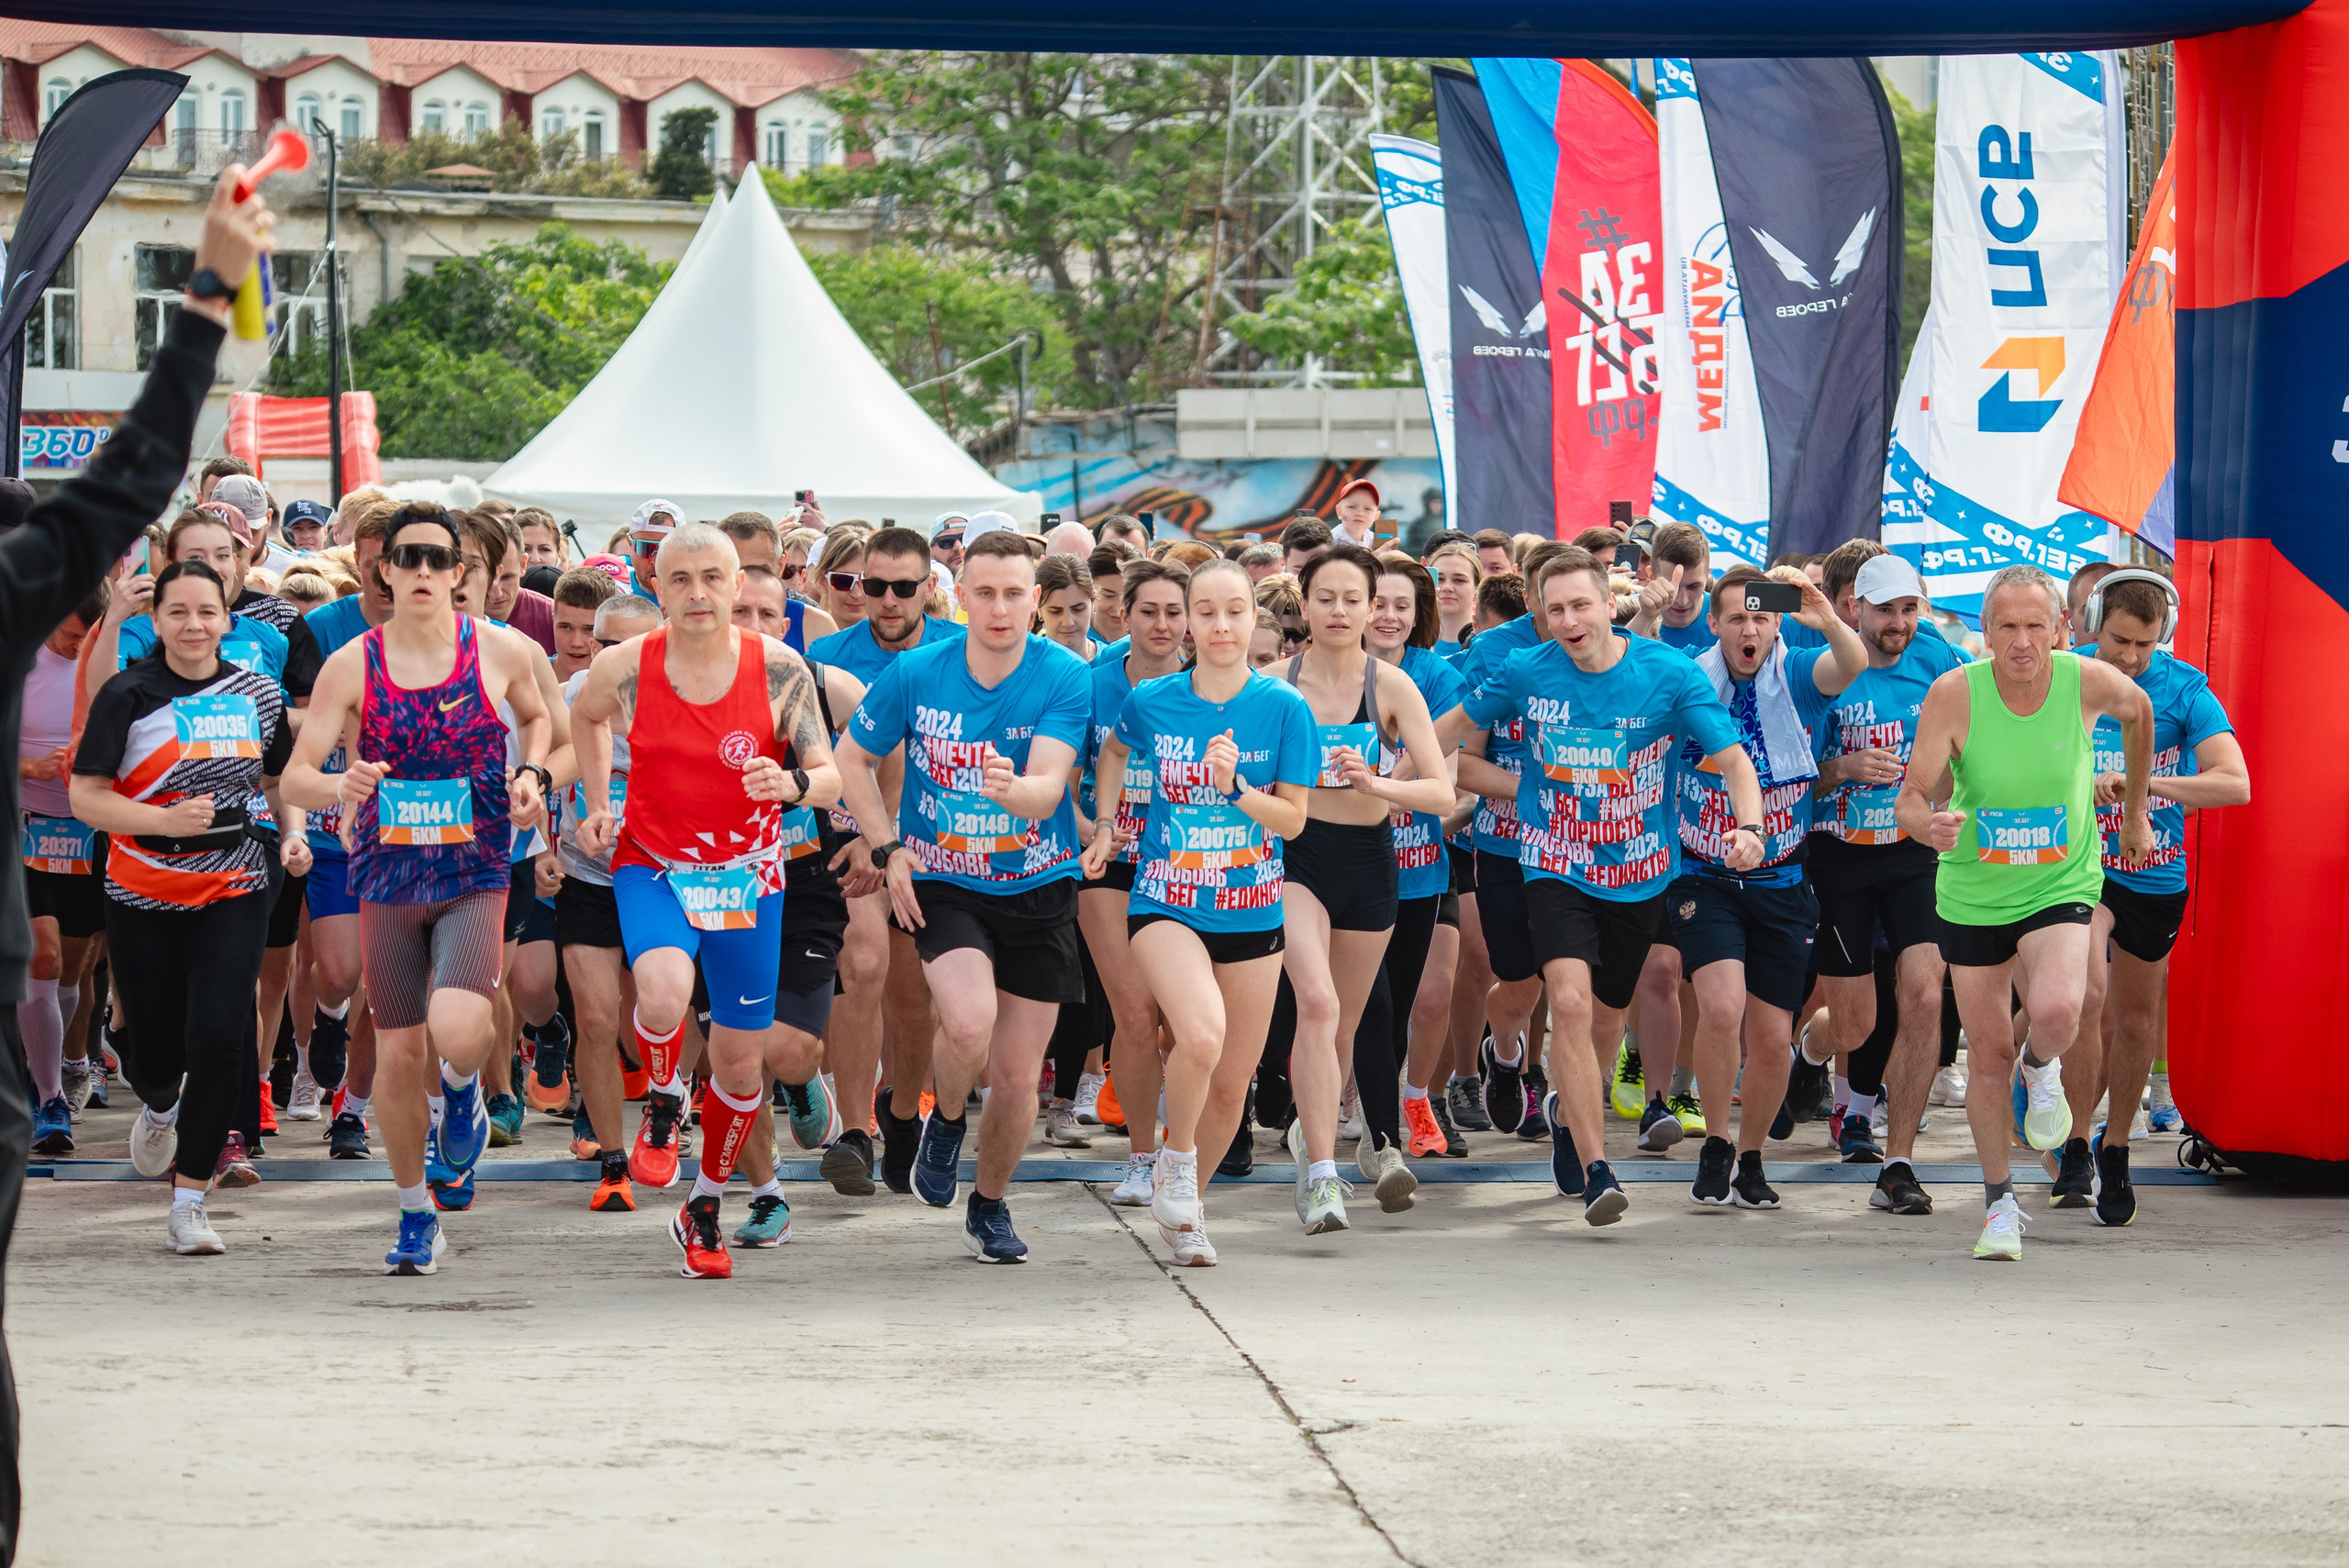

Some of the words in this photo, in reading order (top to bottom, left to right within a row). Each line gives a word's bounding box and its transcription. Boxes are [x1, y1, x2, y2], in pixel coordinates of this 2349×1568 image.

[855, 704, 876, 731] ПСБ
[1527, 695, 1571, 725] 2024
[193, 715, 248, 739] 20035
[915, 705, 963, 740] 2024
[1841, 719, 1905, 749] #МЕЧТА
[209, 740, 239, 759] 5KM
[922, 734, 994, 768] #МЕЧТ
[1154, 733, 1195, 762] 2024
[1557, 745, 1613, 767] 20040
[1628, 735, 1675, 772] #ЦЕЛЬ
[1159, 758, 1214, 786] #МЕЧТ
[2095, 751, 2126, 772] 136
[1572, 768, 1599, 784] 5KM
[950, 794, 963, 802] ПСБ
[1124, 787, 1152, 805] 5KM
[1538, 789, 1581, 820] ЗАБЕГ
[1598, 782, 1664, 821] #МОМЕН
[397, 800, 454, 825] 20144
[954, 812, 1010, 836] 20146
[1863, 807, 1896, 828] 202
[411, 826, 442, 845] 5KM
[1187, 826, 1246, 850] 20075
[1394, 823, 1431, 849] 2024
[1548, 812, 1645, 845] #ГОРДОСТЬ
[1677, 813, 1732, 860] #ЛЮБОВ
[1874, 828, 1898, 845] 5KM
[1995, 826, 2051, 848] 20018
[38, 836, 83, 857] 20371
[966, 837, 996, 854] 5KM
[1023, 831, 1060, 871] 2024
[1624, 829, 1659, 862] 2024
[2009, 849, 2038, 865] 5KM
[48, 857, 72, 873] 5KM
[691, 863, 726, 872] TITAN
[1202, 850, 1232, 869] 5KM
[1584, 843, 1671, 889] #ЕДИНСТВО
[683, 886, 741, 910] 20043
[1214, 876, 1284, 910] #ЕДИНСТ
[699, 911, 725, 931] 5KM
[698, 1010, 712, 1022] NIK
